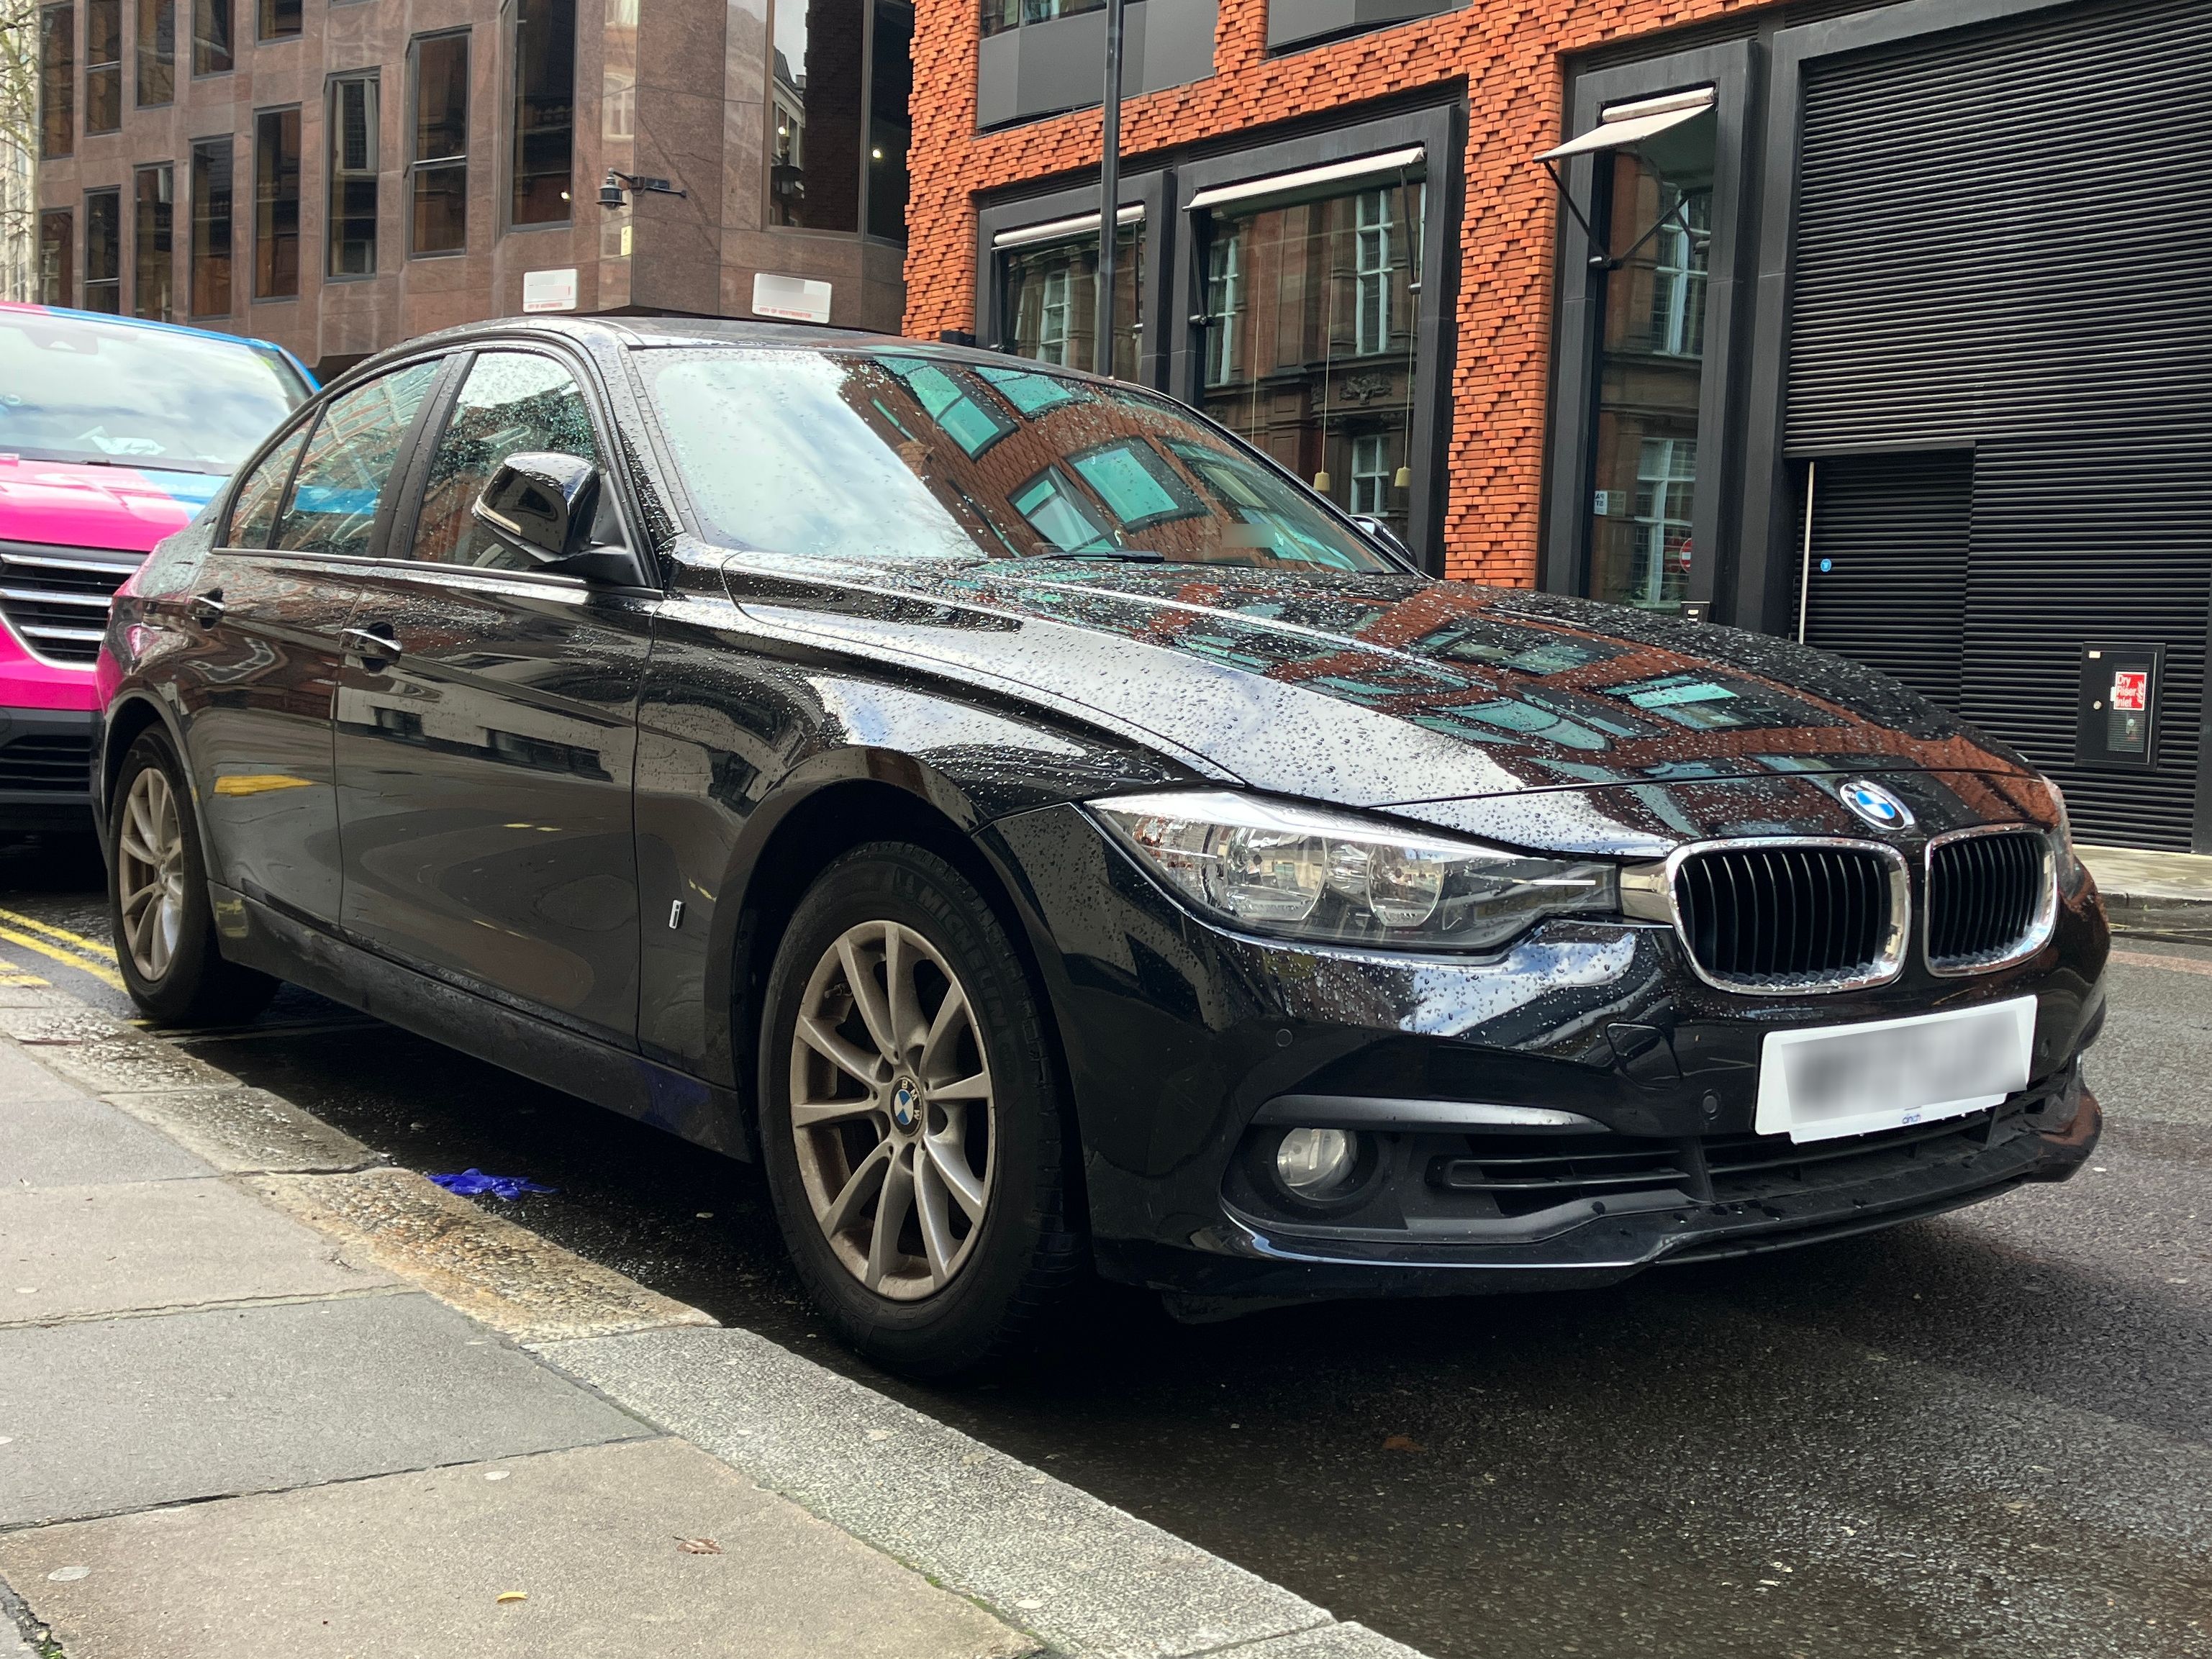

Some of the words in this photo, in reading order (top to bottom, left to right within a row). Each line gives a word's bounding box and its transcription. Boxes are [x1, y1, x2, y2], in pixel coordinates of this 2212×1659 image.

[2117, 675, 2131, 688] Dry
[2116, 686, 2137, 696] Riser
[2115, 696, 2132, 707] Inlet
[919, 885, 1007, 1027] MICHELIN
[901, 1079, 921, 1120] BMW
